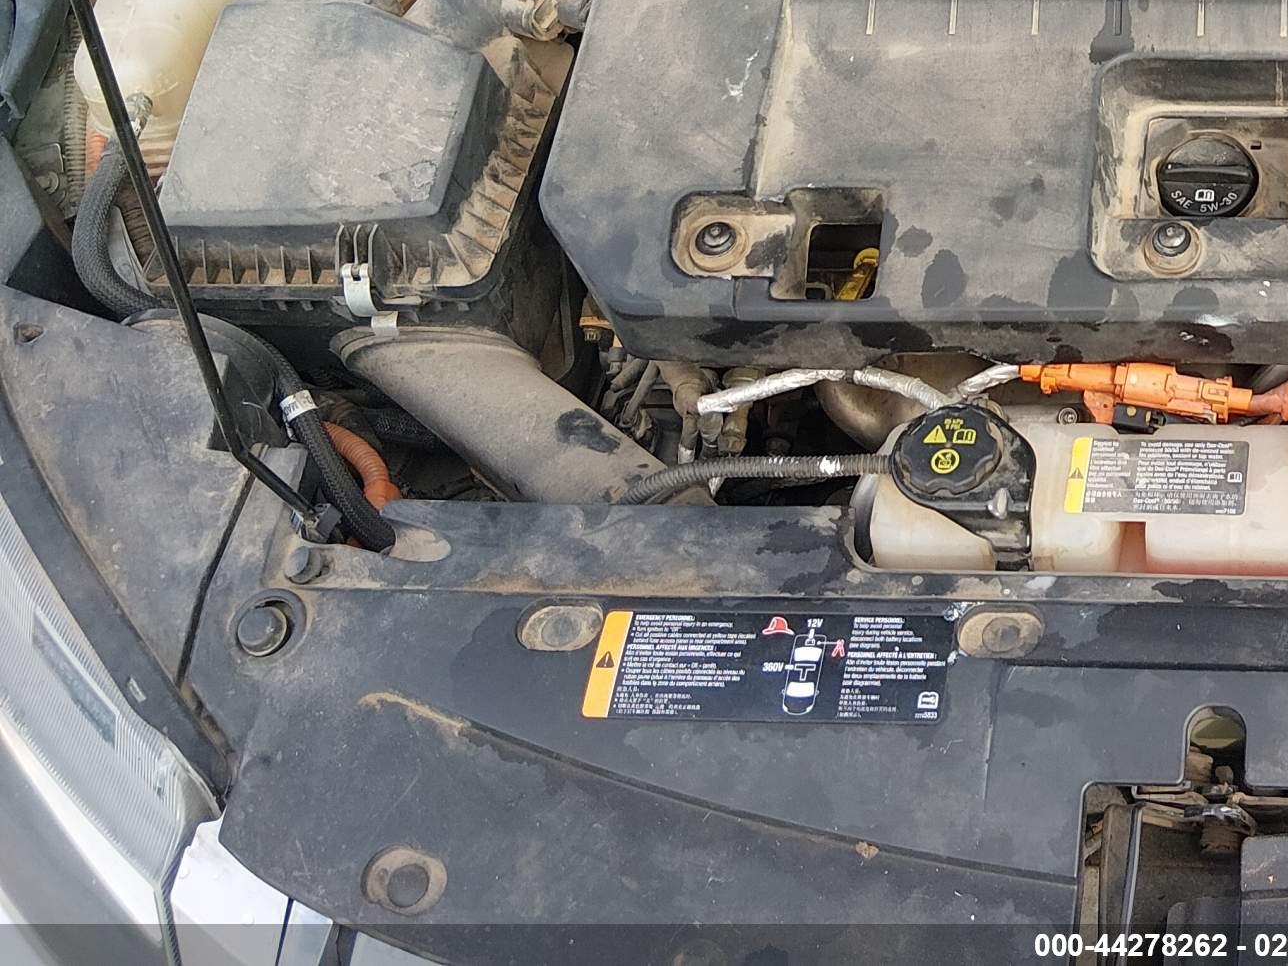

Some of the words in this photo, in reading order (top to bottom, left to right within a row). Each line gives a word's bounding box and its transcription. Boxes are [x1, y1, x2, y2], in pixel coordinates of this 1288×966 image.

[1170, 190, 1194, 210] SAE
[1199, 192, 1238, 213] 5W-30
[807, 618, 824, 628] 12V
[762, 662, 784, 672] 360V
